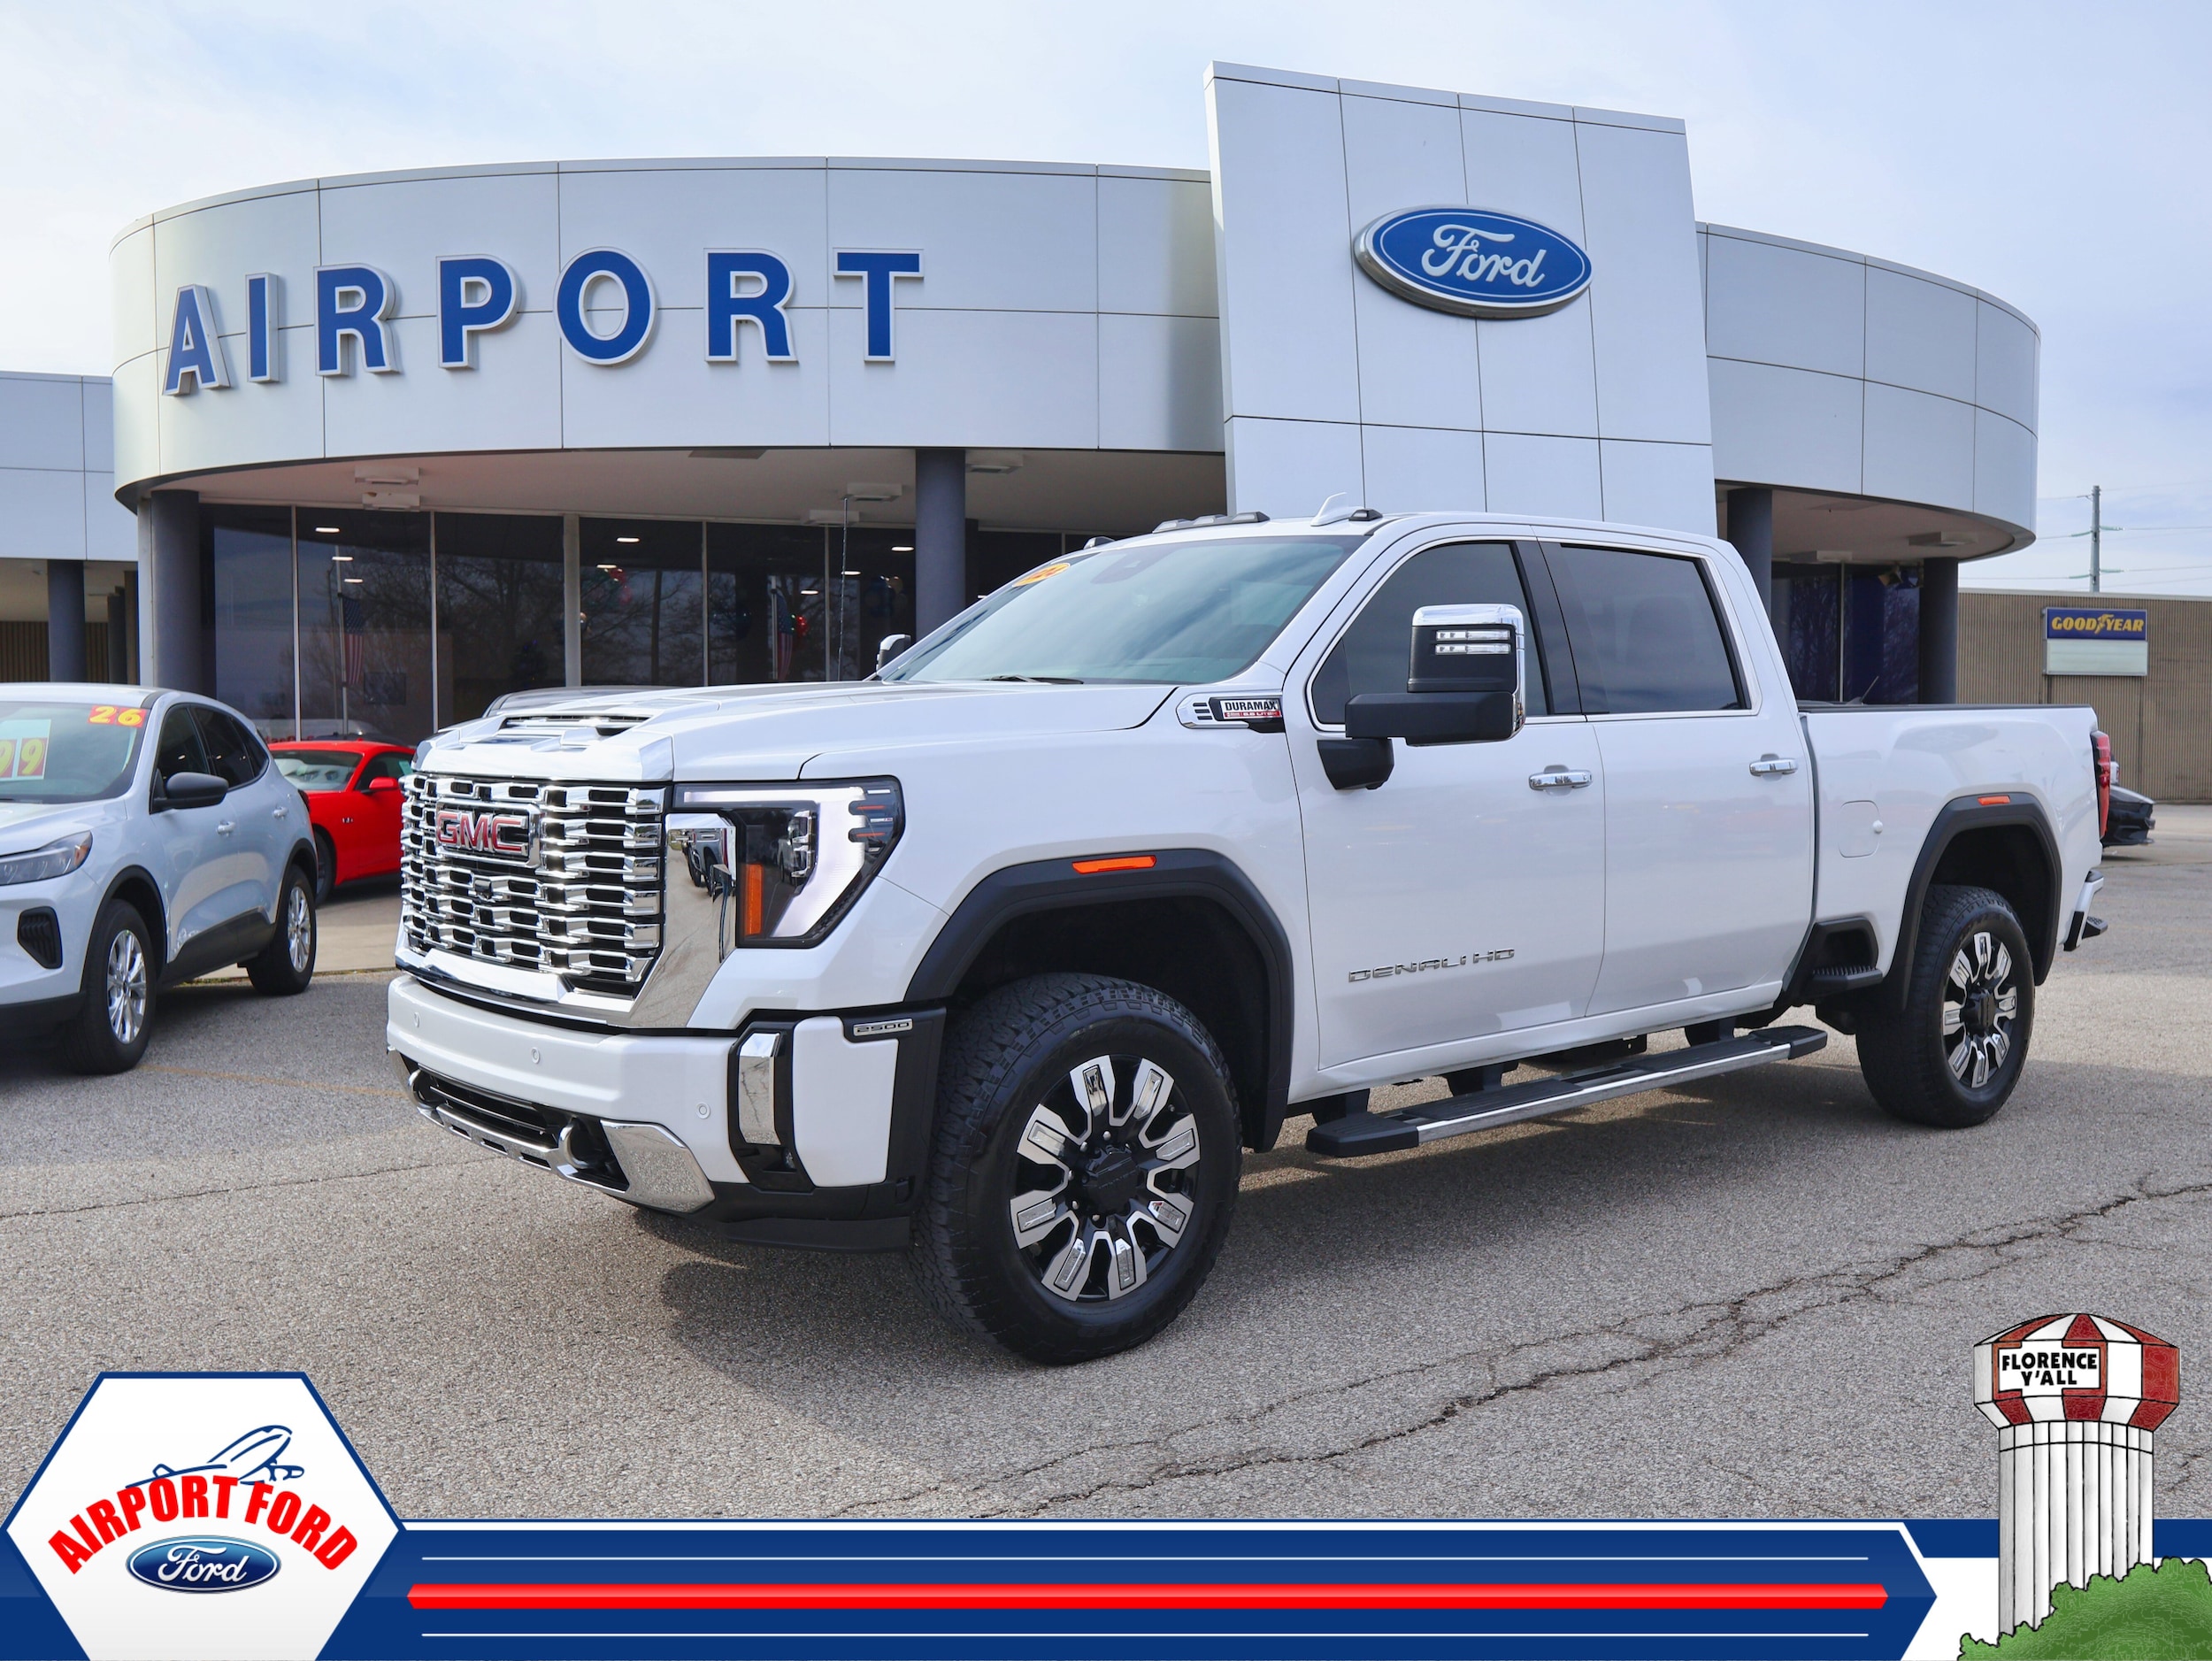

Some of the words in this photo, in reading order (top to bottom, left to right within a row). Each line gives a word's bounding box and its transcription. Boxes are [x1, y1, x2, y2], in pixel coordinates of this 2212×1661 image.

[1421, 223, 1548, 288] Ford
[162, 245, 925, 396] AIRPORT
[2051, 614, 2145, 634] GOODYEAR
[89, 705, 142, 727] 26
[1225, 700, 1276, 711] DURAMAX
[437, 809, 528, 855] GMC
[1348, 955, 1466, 982] DENALI
[1473, 948, 1515, 964] HD
[856, 1021, 910, 1033] 2500
